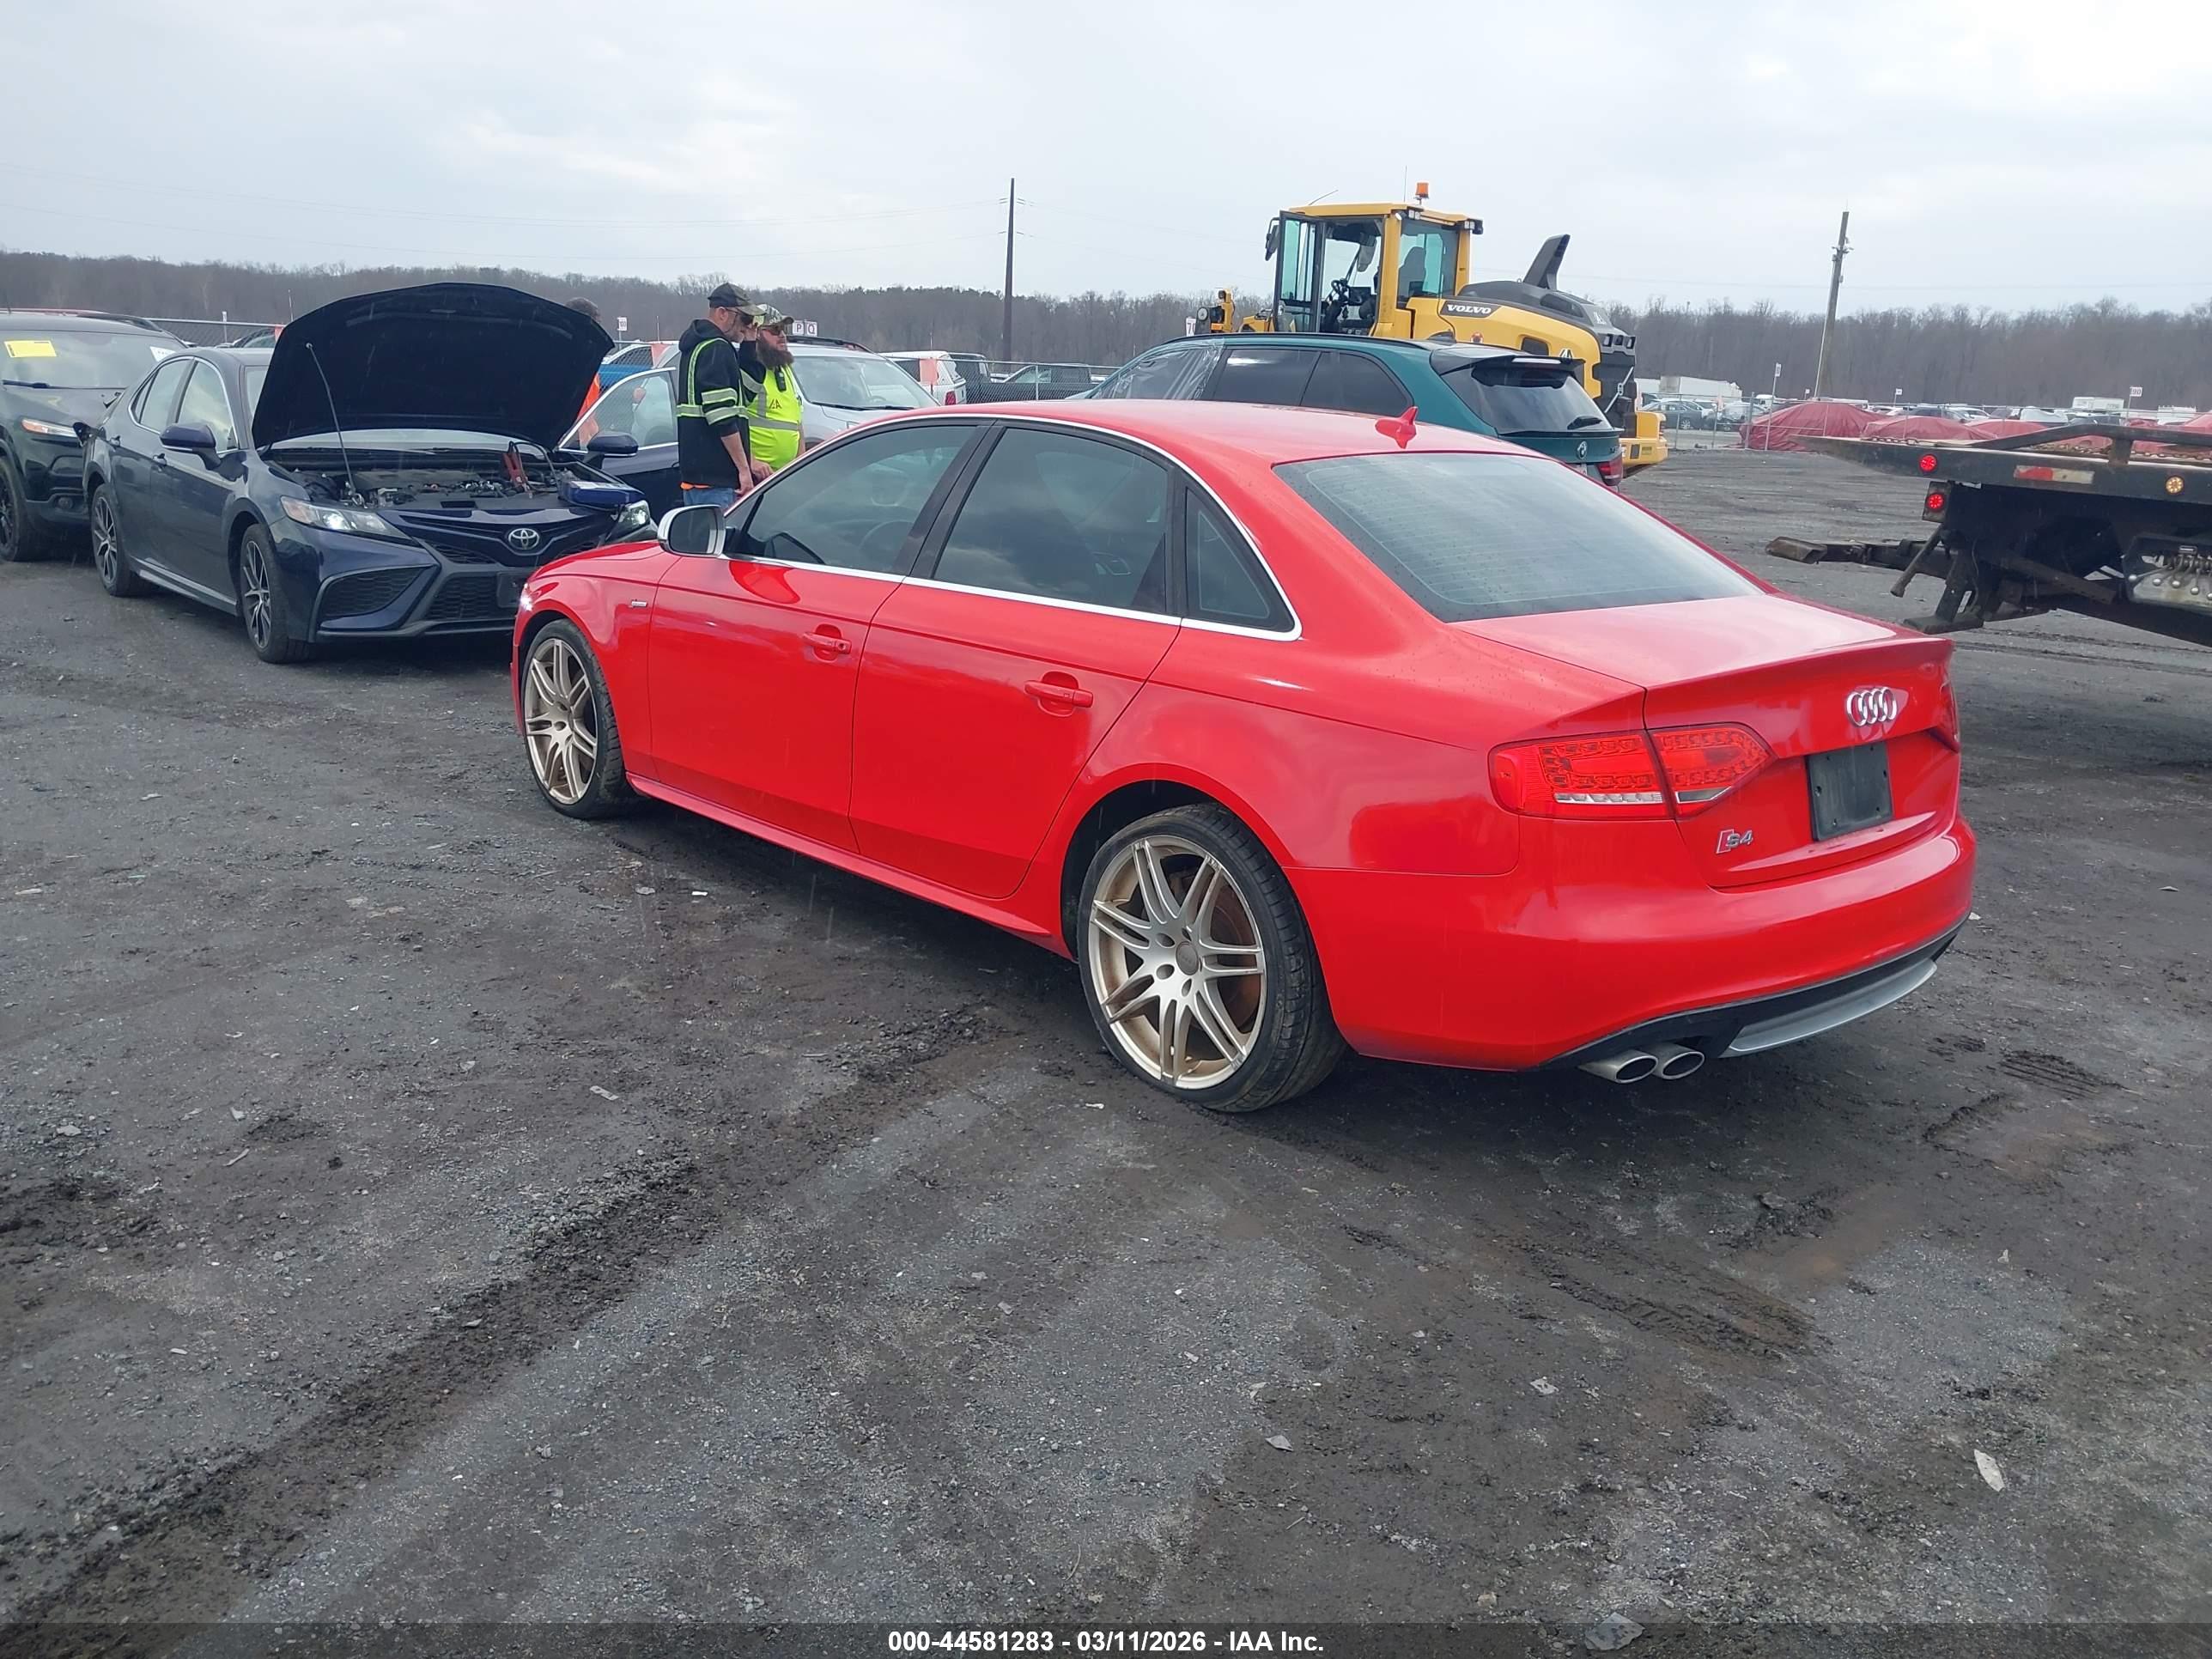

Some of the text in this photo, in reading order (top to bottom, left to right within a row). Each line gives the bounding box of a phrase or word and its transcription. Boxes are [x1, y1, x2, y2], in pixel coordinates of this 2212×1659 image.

[1447, 304, 1492, 314] VOLVO
[796, 324, 802, 333] P
[808, 324, 816, 335] Q
[1726, 830, 1753, 848] S4
